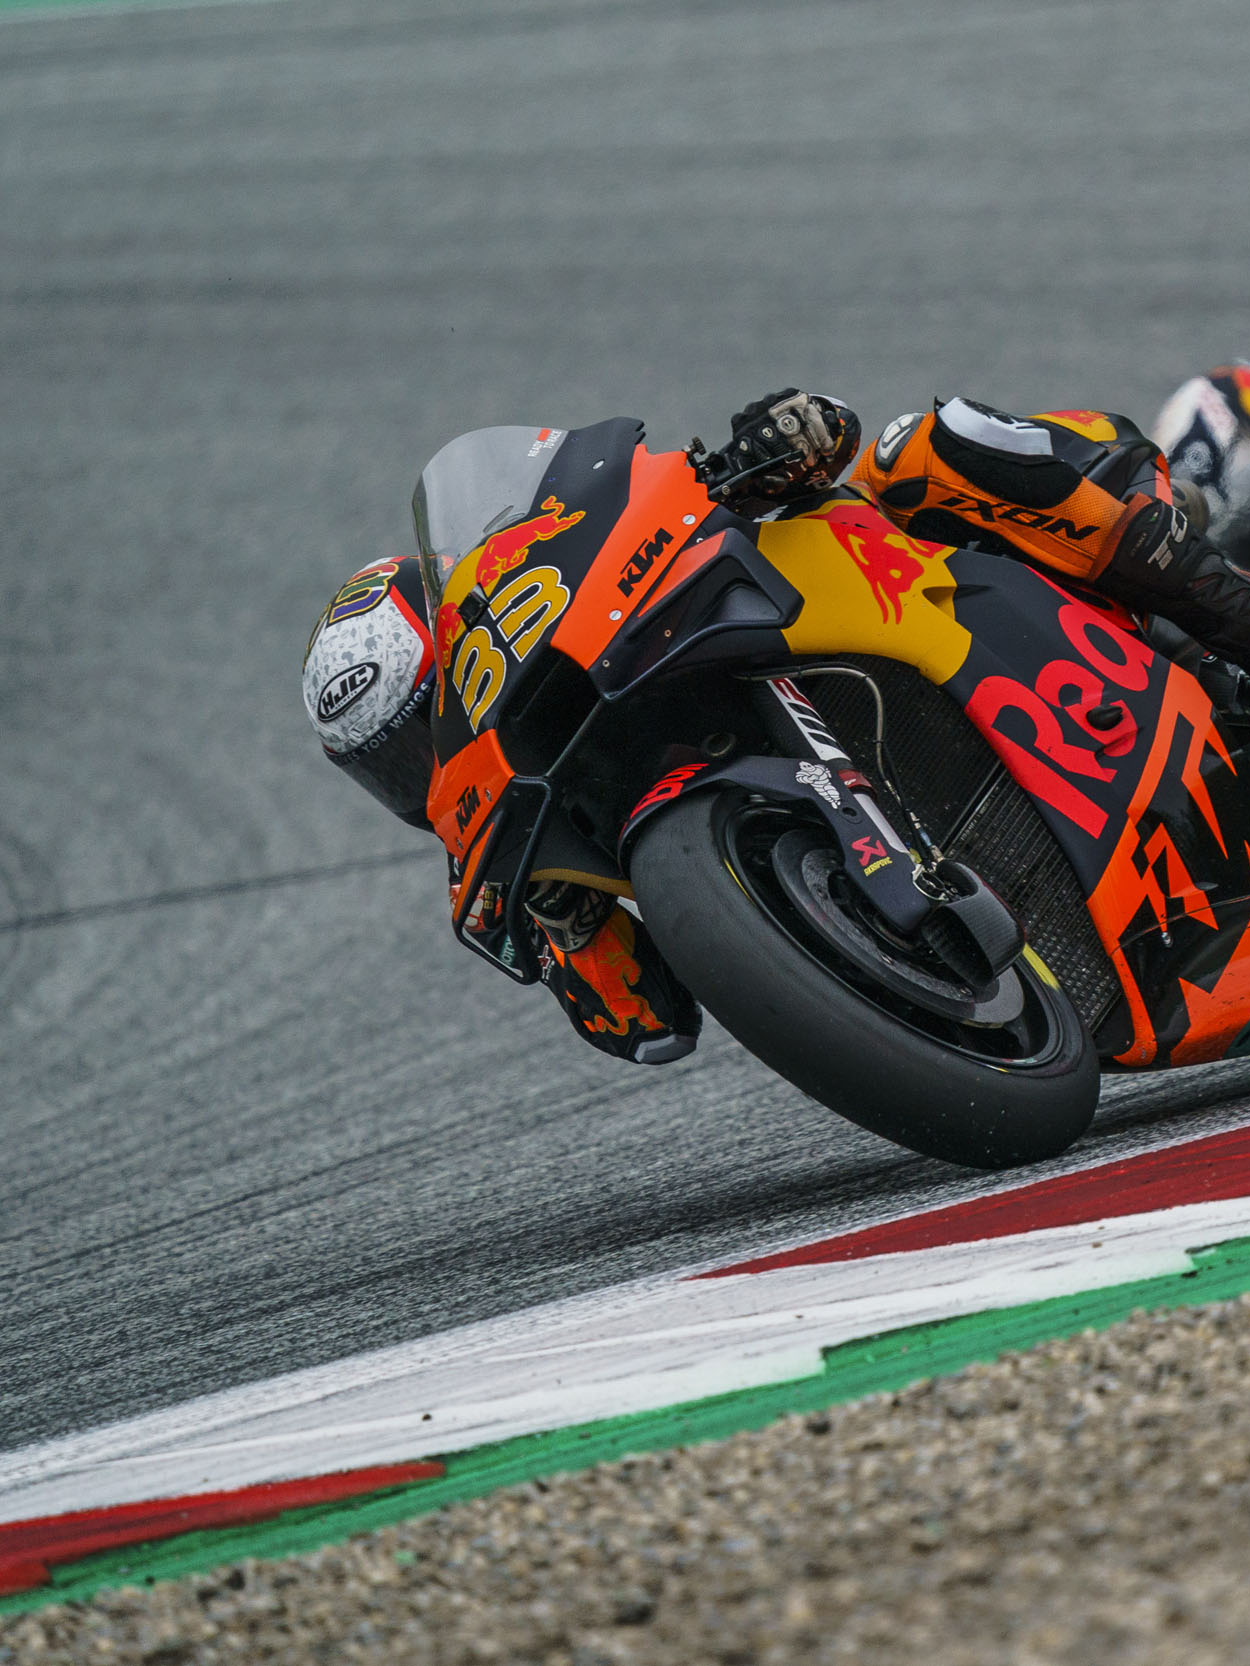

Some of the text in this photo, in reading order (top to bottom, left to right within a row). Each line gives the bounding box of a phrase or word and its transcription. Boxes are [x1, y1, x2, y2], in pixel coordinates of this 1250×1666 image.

[938, 496, 1100, 541] IXON
[616, 528, 675, 597] KTM
[452, 566, 571, 734] 33
[321, 665, 369, 715] HJC
[361, 731, 388, 753] YOU
[389, 682, 431, 729] WINGS
[455, 784, 481, 835] KTM
